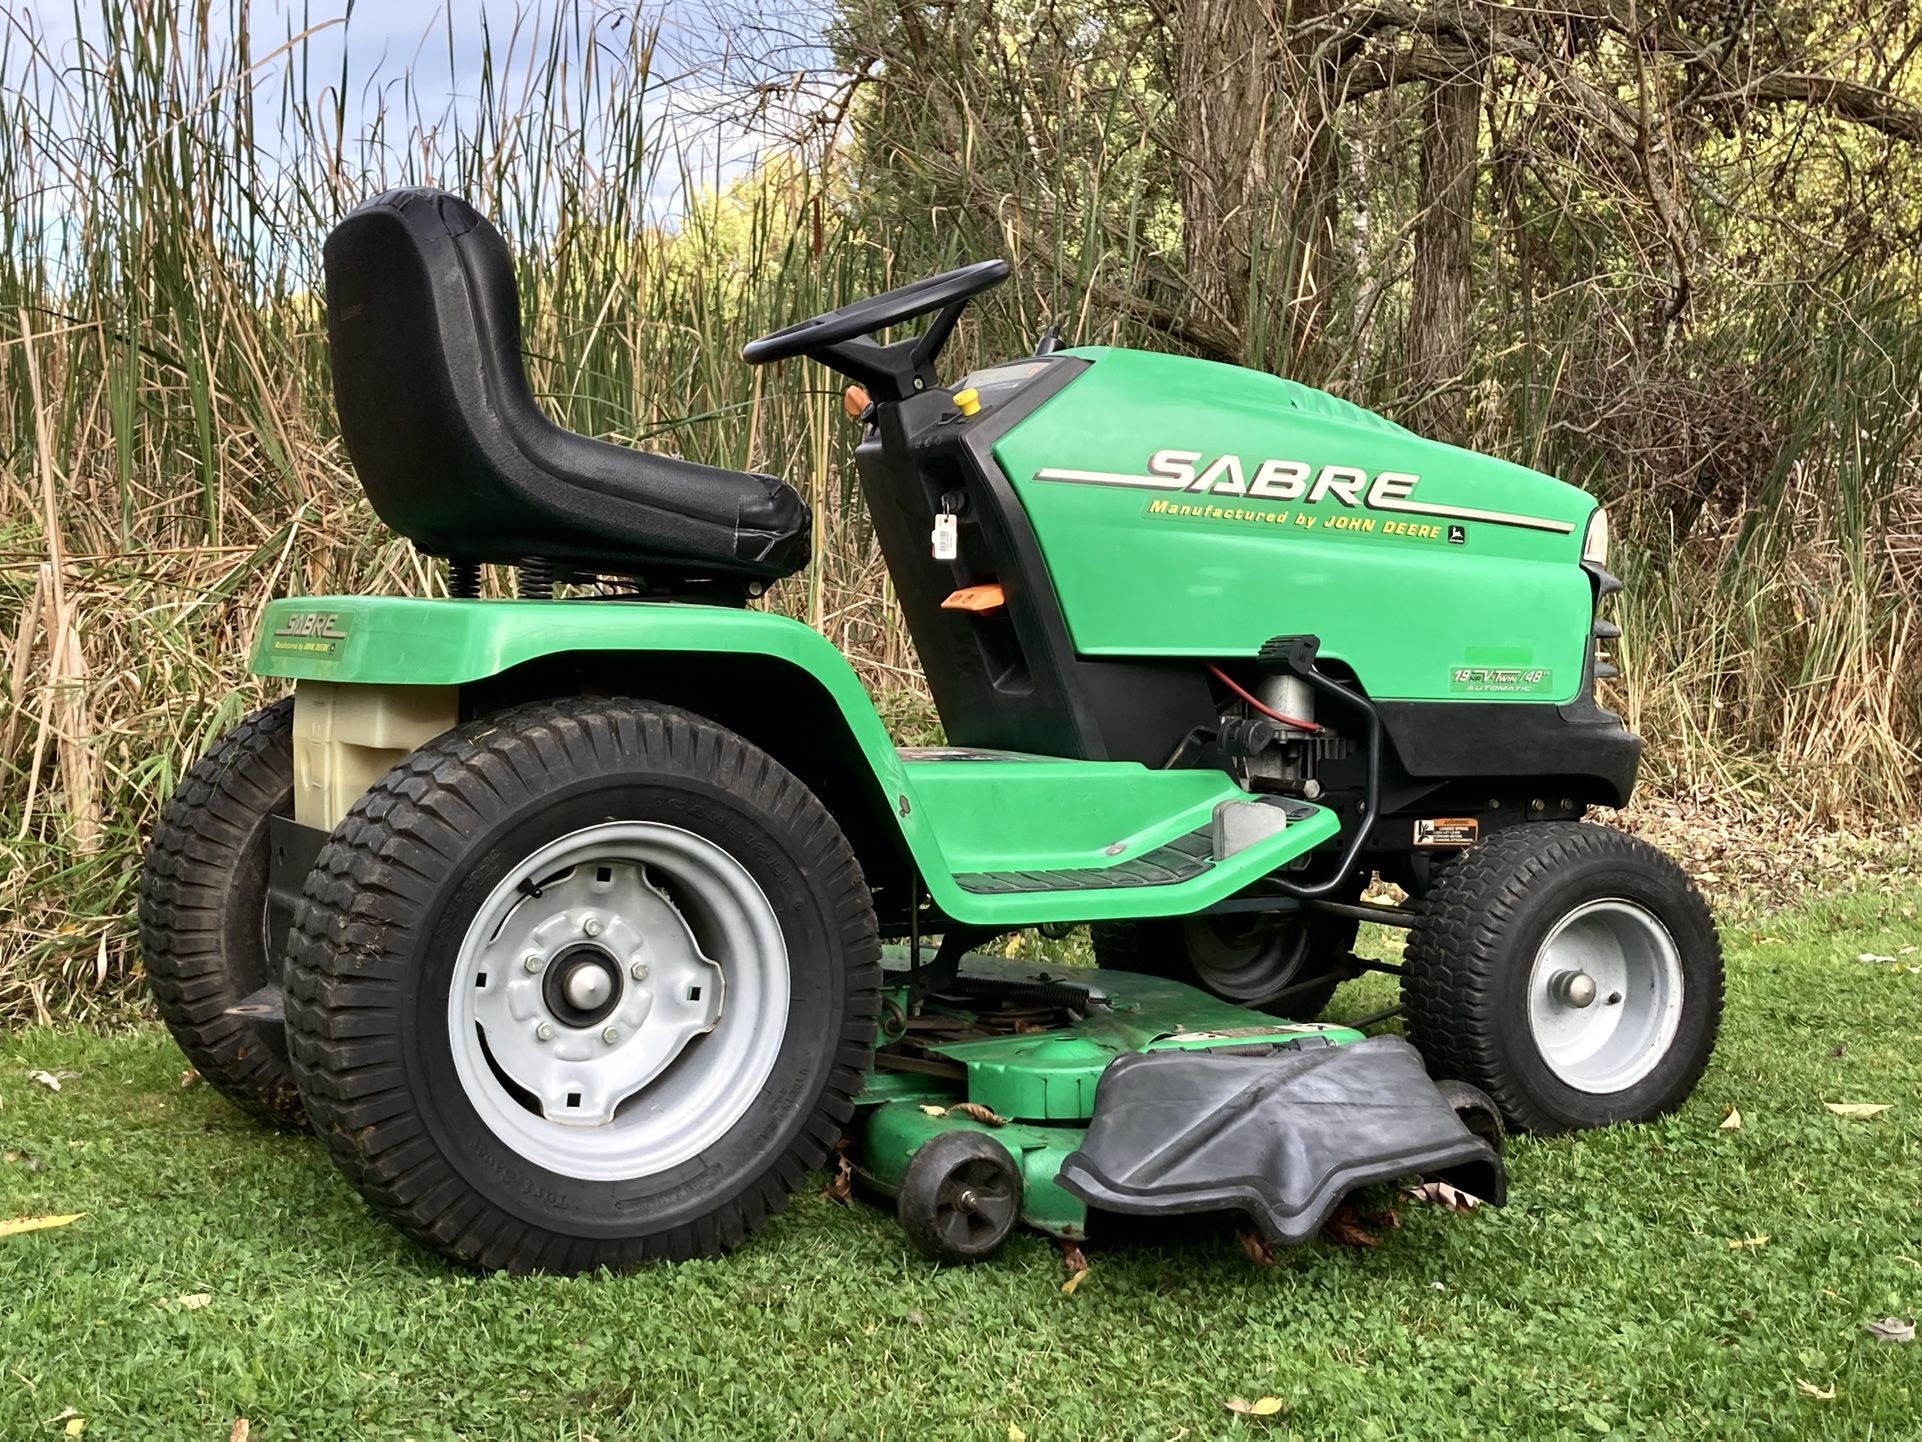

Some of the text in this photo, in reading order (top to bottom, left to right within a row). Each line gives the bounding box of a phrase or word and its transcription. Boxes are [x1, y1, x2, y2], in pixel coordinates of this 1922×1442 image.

[1148, 449, 1420, 509] SABRE
[1149, 500, 1442, 540] Manufactured by JOHN DEERE
[287, 613, 339, 638] SABRE
[1466, 684, 1533, 692] AUTOMATIC
